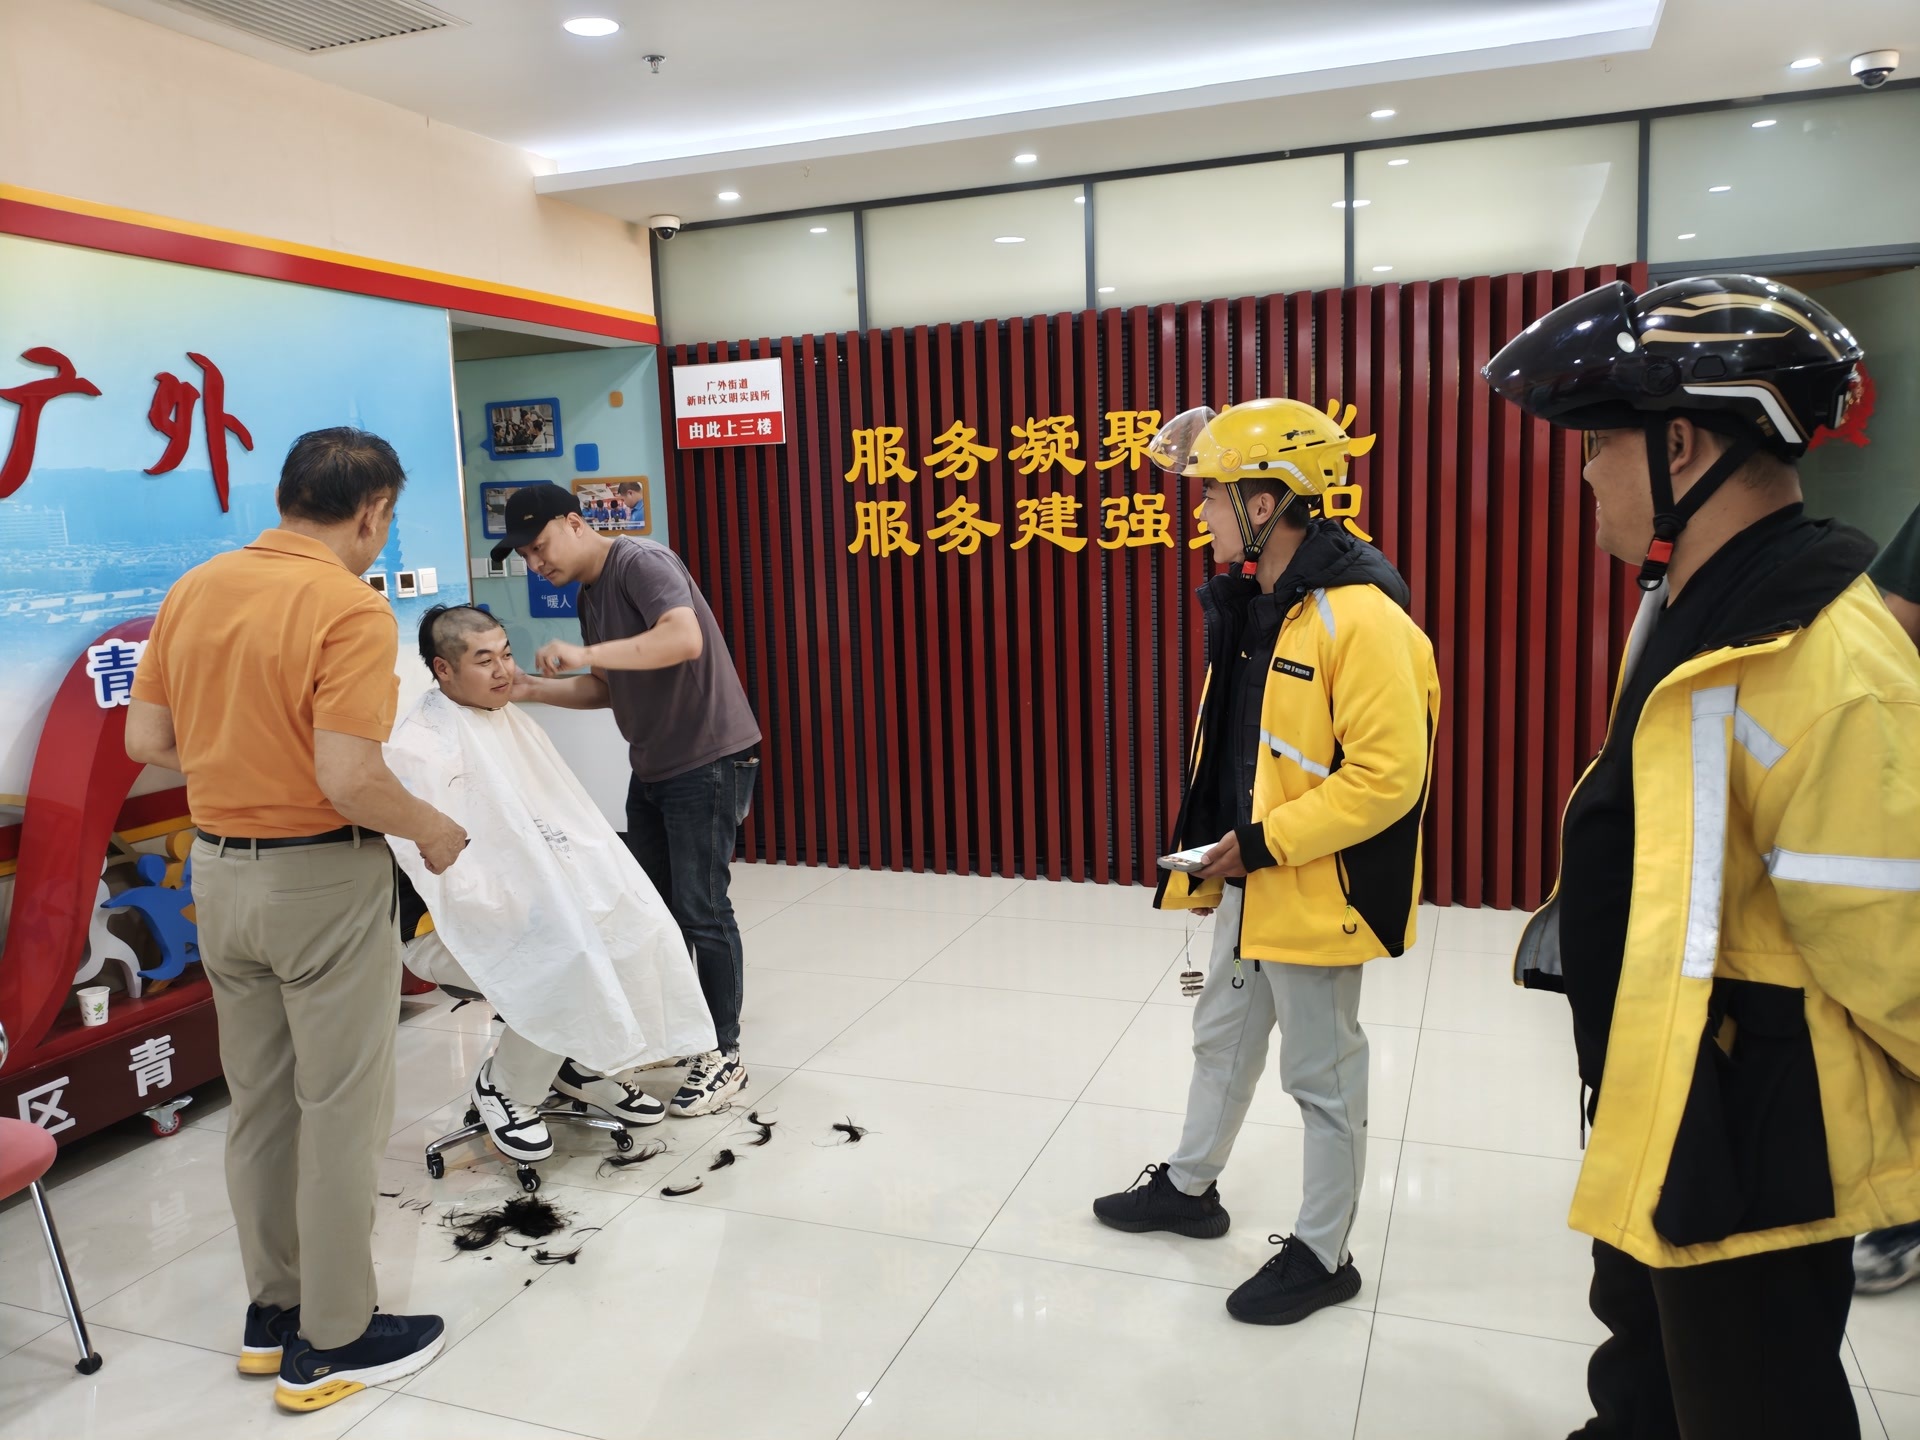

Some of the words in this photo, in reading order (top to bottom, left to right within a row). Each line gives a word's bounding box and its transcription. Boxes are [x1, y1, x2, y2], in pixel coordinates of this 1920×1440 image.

[706, 378, 748, 391] 广外街道
[687, 390, 770, 406] 新时代文明实践所
[0, 347, 254, 513] 广外
[689, 418, 772, 439] 由此上三楼
[848, 484, 1373, 558] 服务建强织
